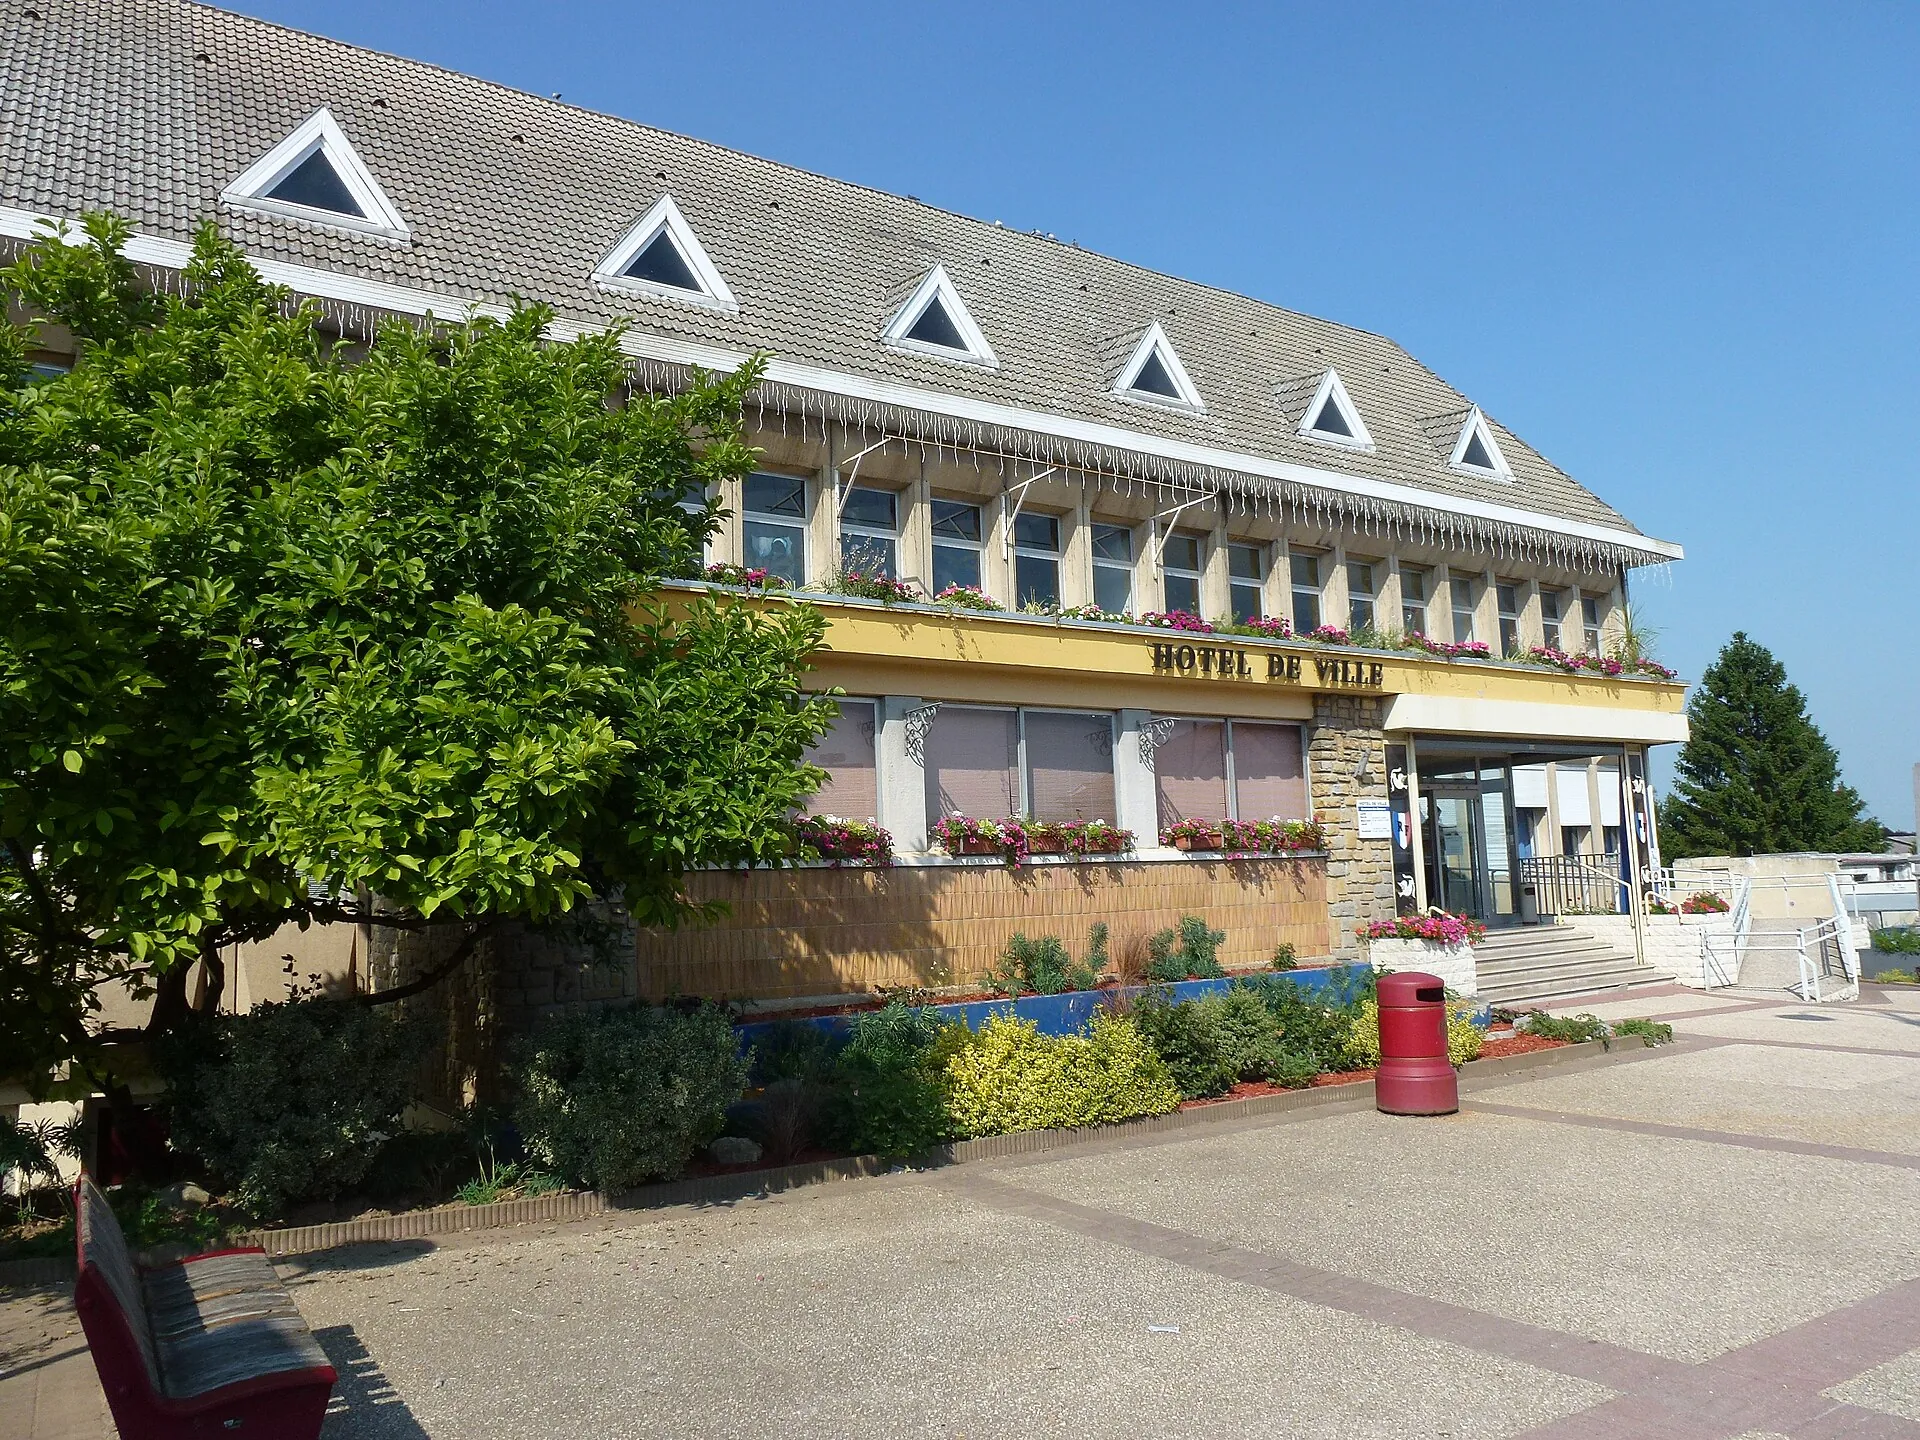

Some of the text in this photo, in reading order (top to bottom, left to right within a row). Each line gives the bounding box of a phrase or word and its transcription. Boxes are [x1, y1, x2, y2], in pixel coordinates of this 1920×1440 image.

[1151, 642, 1383, 686] HOTEL DE VILLE
